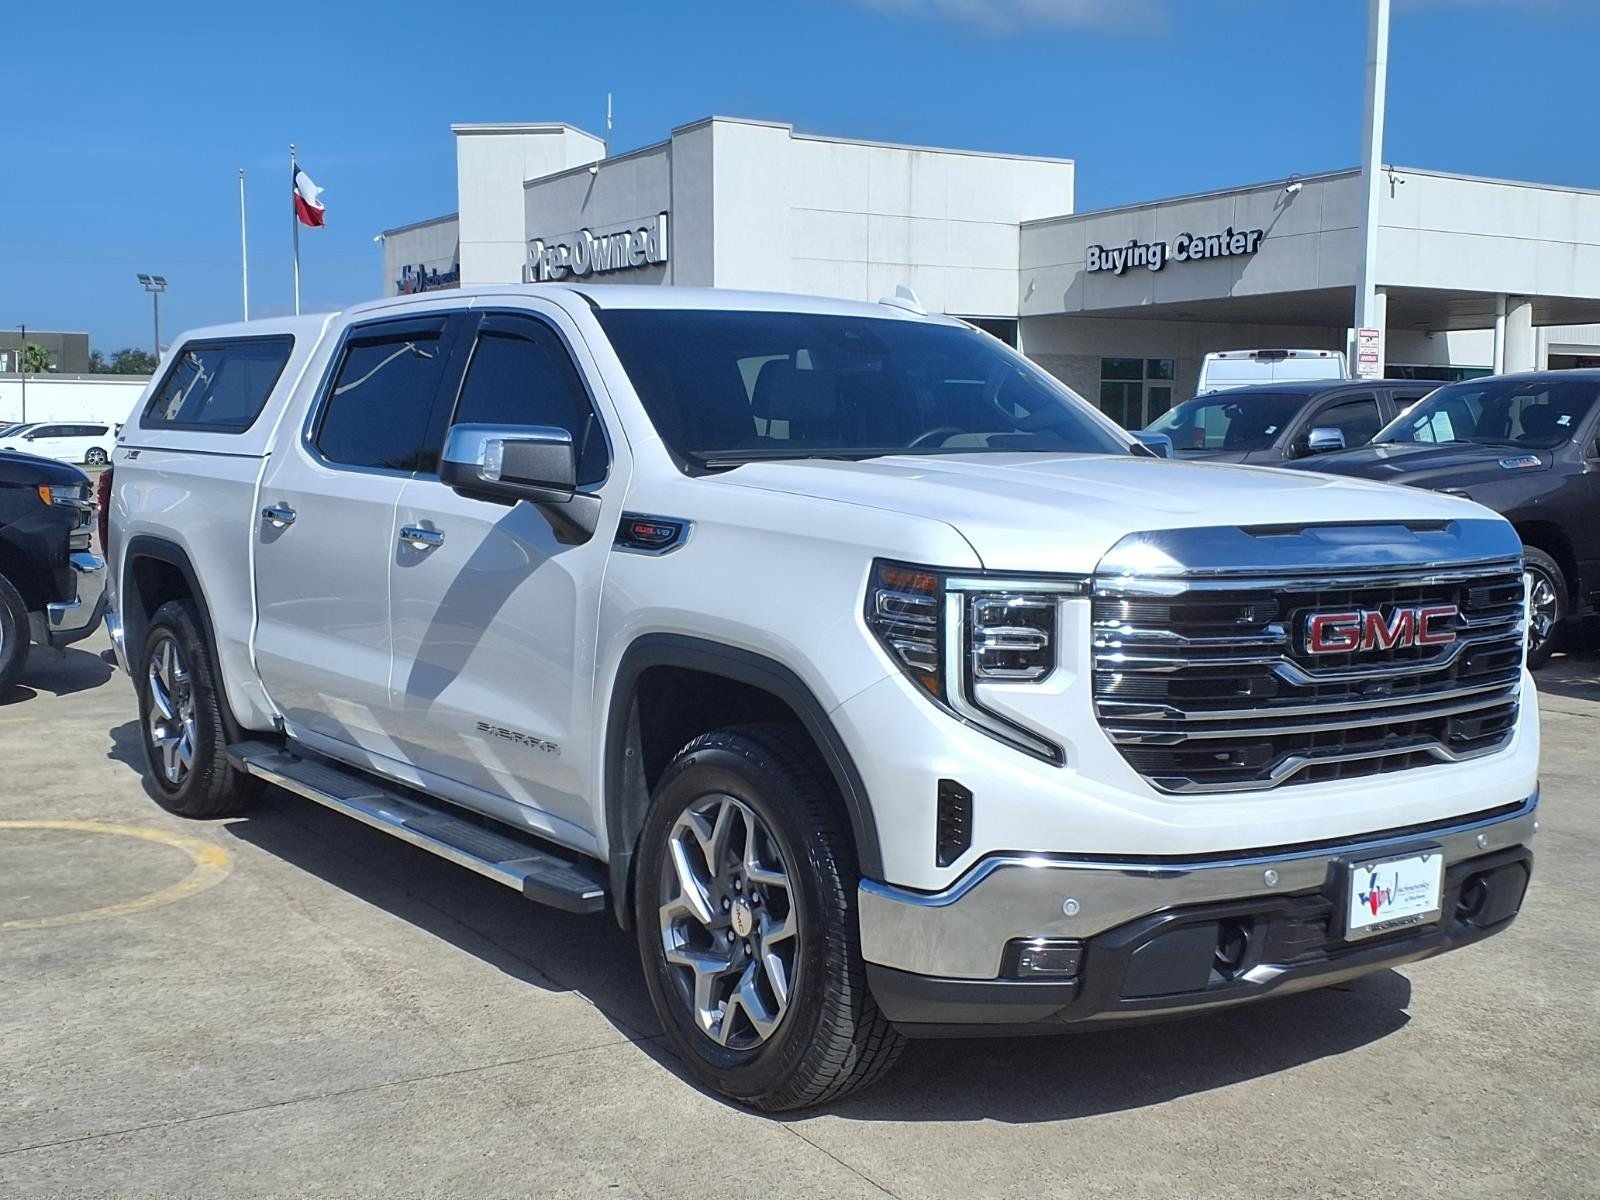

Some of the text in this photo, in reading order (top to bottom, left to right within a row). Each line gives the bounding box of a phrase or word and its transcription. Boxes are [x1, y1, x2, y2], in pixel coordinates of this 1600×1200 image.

[525, 211, 667, 282] Pre-Owned
[1086, 227, 1262, 275] Buying Center
[1306, 605, 1457, 654] GMC
